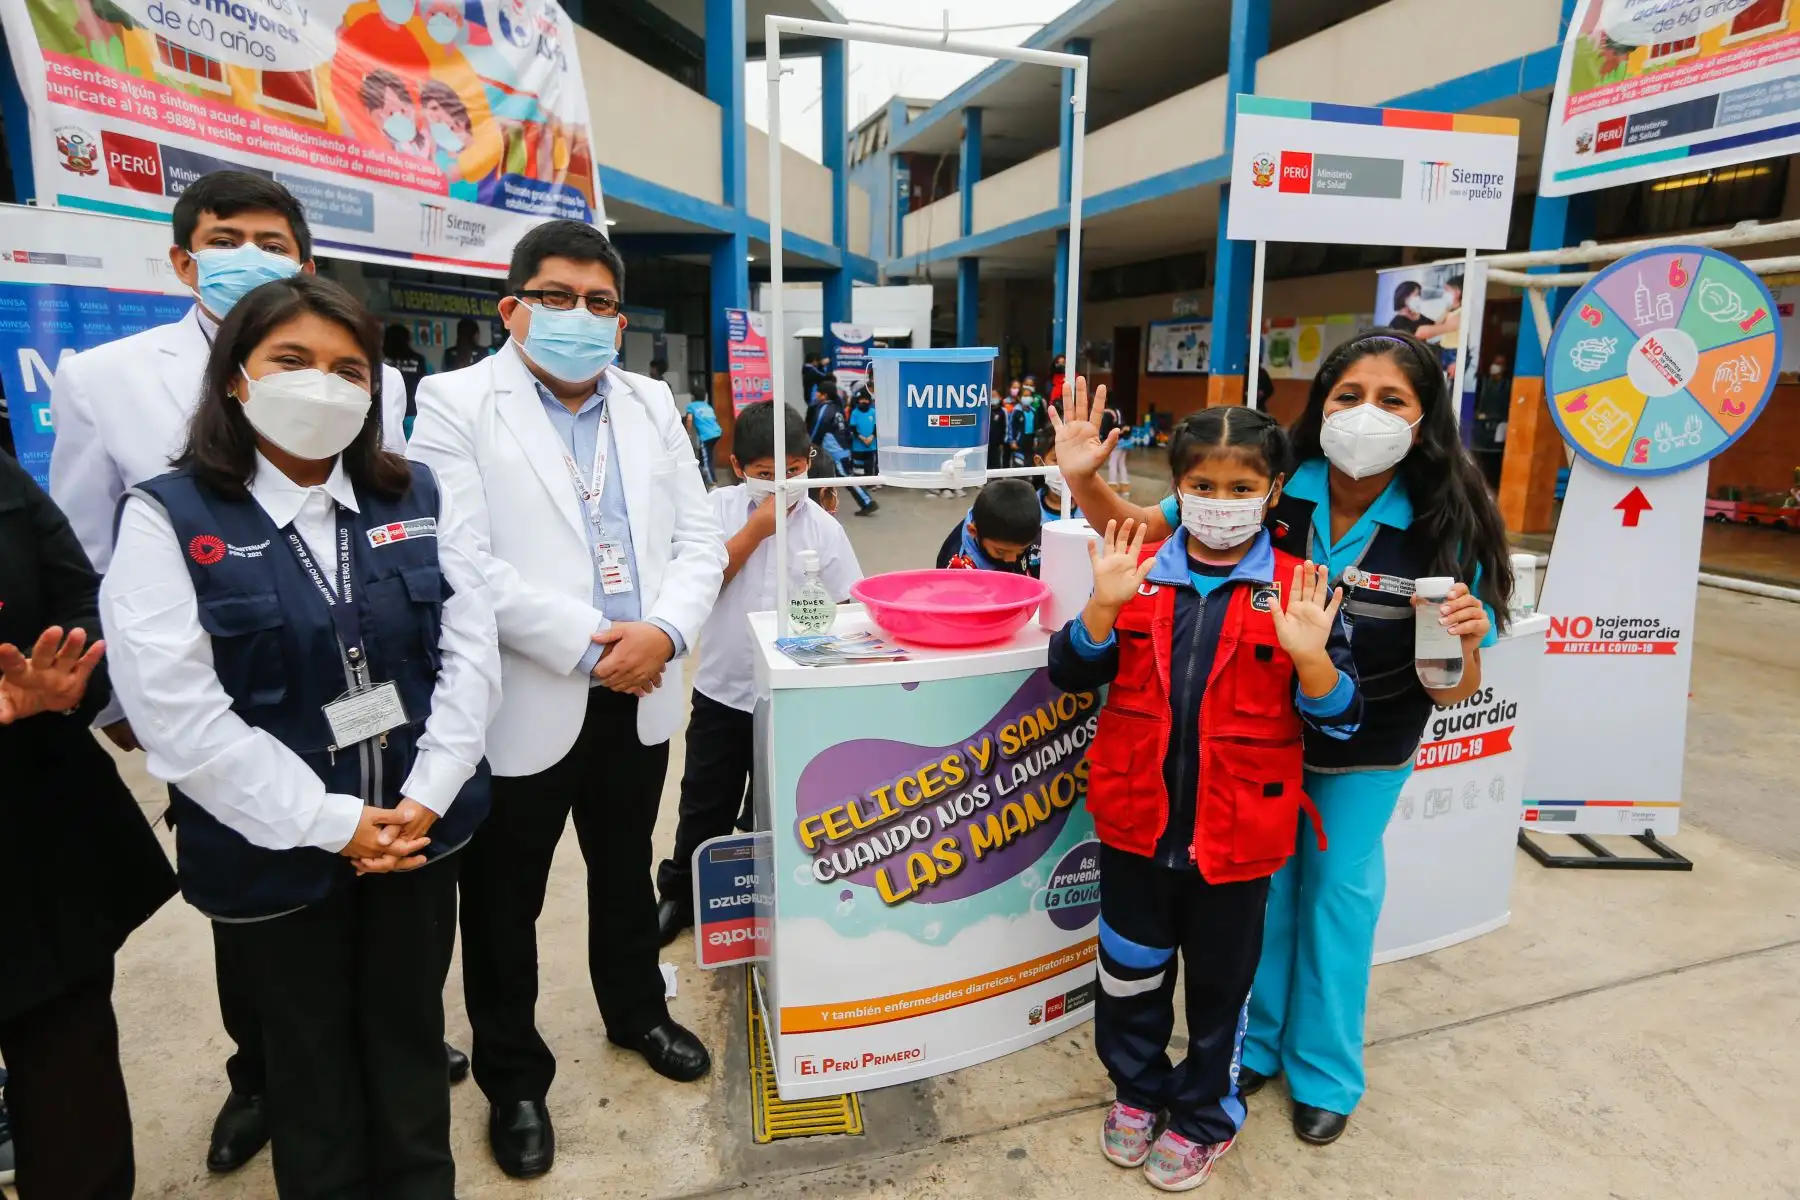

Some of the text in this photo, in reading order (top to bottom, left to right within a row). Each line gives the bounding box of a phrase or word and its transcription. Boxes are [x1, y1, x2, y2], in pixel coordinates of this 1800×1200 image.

[148, 2, 276, 62] de 60 años
[45, 60, 118, 89] resentas
[121, 80, 157, 101] algún
[159, 91, 207, 117] síntoma
[209, 109, 246, 128] acude
[249, 115, 260, 130] al
[120, 99, 132, 113] al
[198, 124, 205, 136] y
[207, 125, 243, 144] recibe
[1598, 119, 1668, 143] PERÚ Ministerio
[109, 151, 157, 177] PERÚ
[1283, 165, 1352, 180] PERÚ Ministerio
[171, 183, 185, 194] de
[1316, 179, 1347, 190] de Salud
[1452, 168, 1504, 188] Siempre
[1468, 186, 1502, 201] pueblo
[447, 214, 486, 234] Siempre
[1668, 258, 1688, 288] 6
[79, 301, 110, 311] MINSA
[118, 303, 146, 313] MINSA
[1580, 304, 1604, 328] 5
[1738, 307, 1767, 334] 1
[1643, 337, 1664, 356] NO
[907, 383, 989, 409] MINSA
[1720, 398, 1746, 416] 2
[1631, 436, 1652, 464] 3
[289, 534, 336, 606] MINISTERIO DE SALUD
[340, 528, 353, 604] MINISTERIO DE SALUD
[1545, 615, 1661, 640] NO bajemos
[1600, 627, 1681, 642] la guardia
[1563, 643, 1654, 653] ANTE LA COVID-19
[1432, 699, 1518, 742] guardia
[1416, 737, 1484, 767] COVID-19
[798, 691, 1095, 850] FELICES Y SANOS
[812, 715, 1098, 882] CUANDO NOS LAVAMOS
[874, 759, 1092, 905] LAS MANOS
[820, 1010, 829, 1022] Y
[831, 1004, 882, 1022] también
[884, 988, 964, 1014] enfermedades
[965, 974, 1018, 996] diarreicas,
[1018, 953, 1075, 980] respiratorias
[1075, 950, 1082, 961] y
[1047, 1002, 1064, 1014] PERÚ
